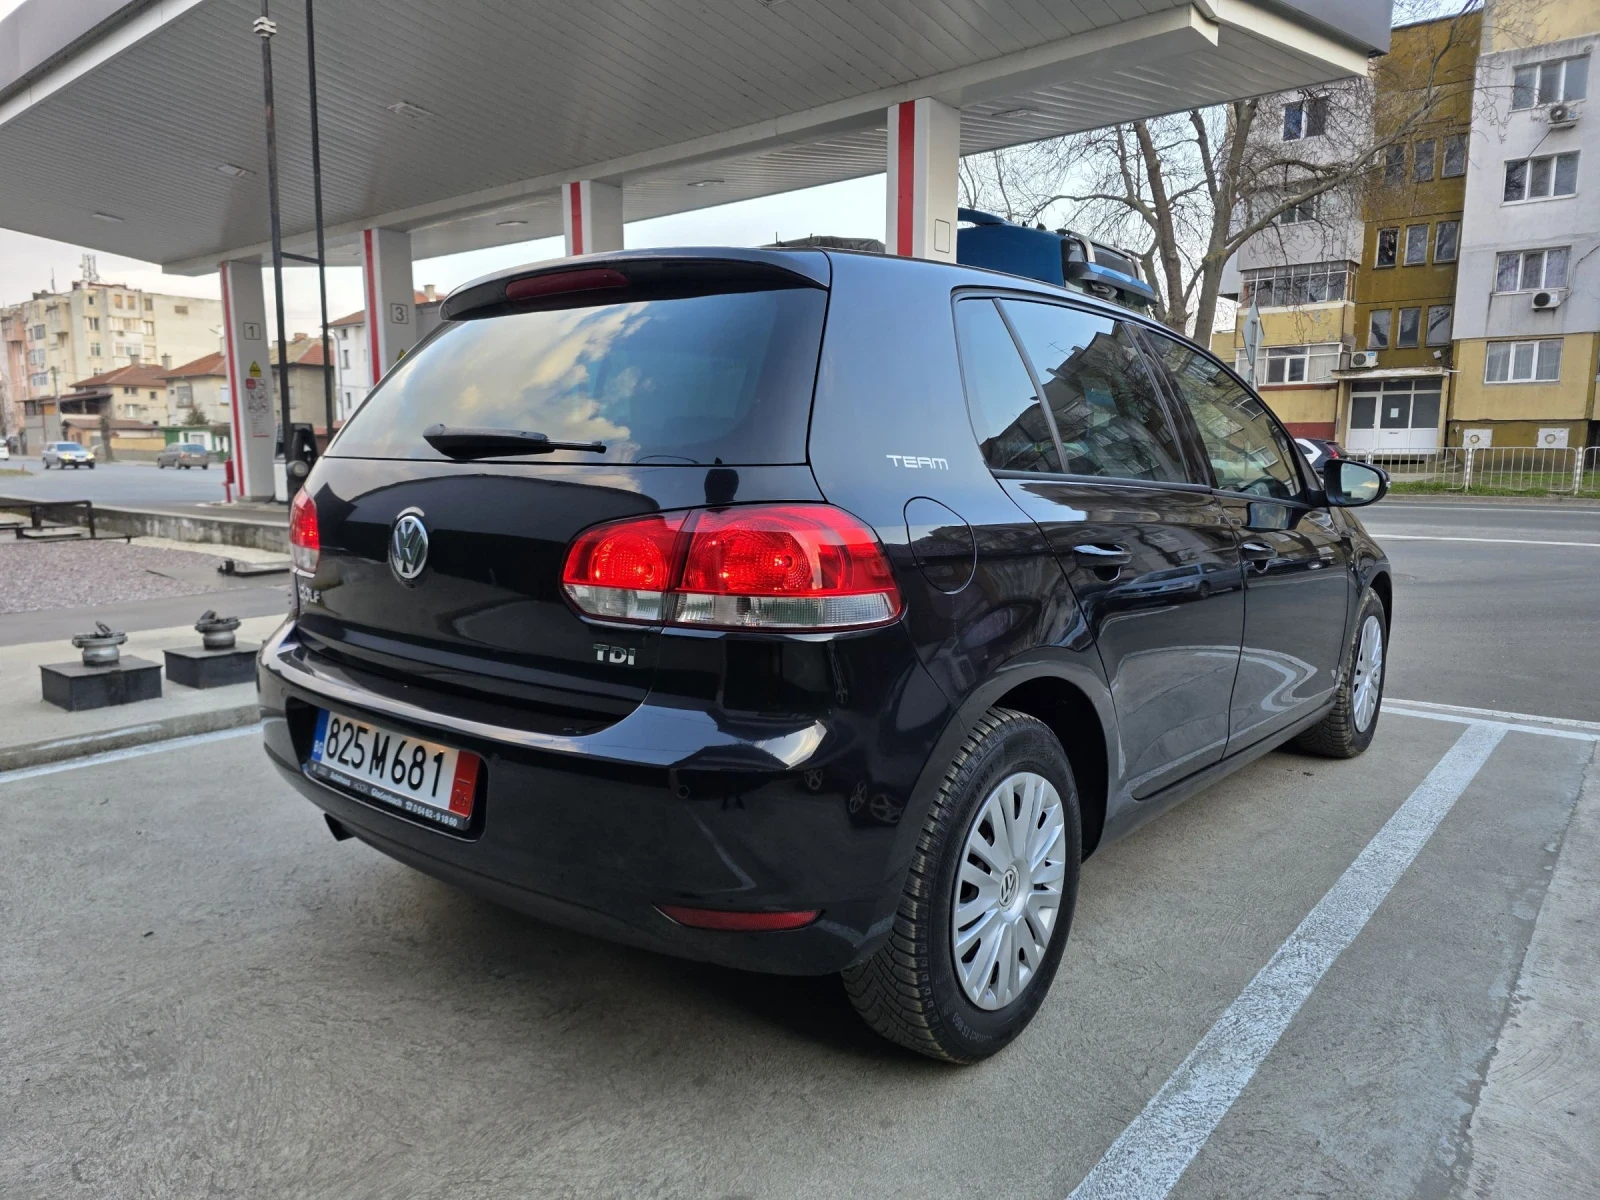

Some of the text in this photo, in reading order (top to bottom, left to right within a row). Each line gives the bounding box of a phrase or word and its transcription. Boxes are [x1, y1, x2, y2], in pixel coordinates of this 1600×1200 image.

[395, 306, 405, 321] 3
[247, 325, 255, 338] 1
[885, 454, 949, 471] TEAM
[313, 740, 324, 754] BG
